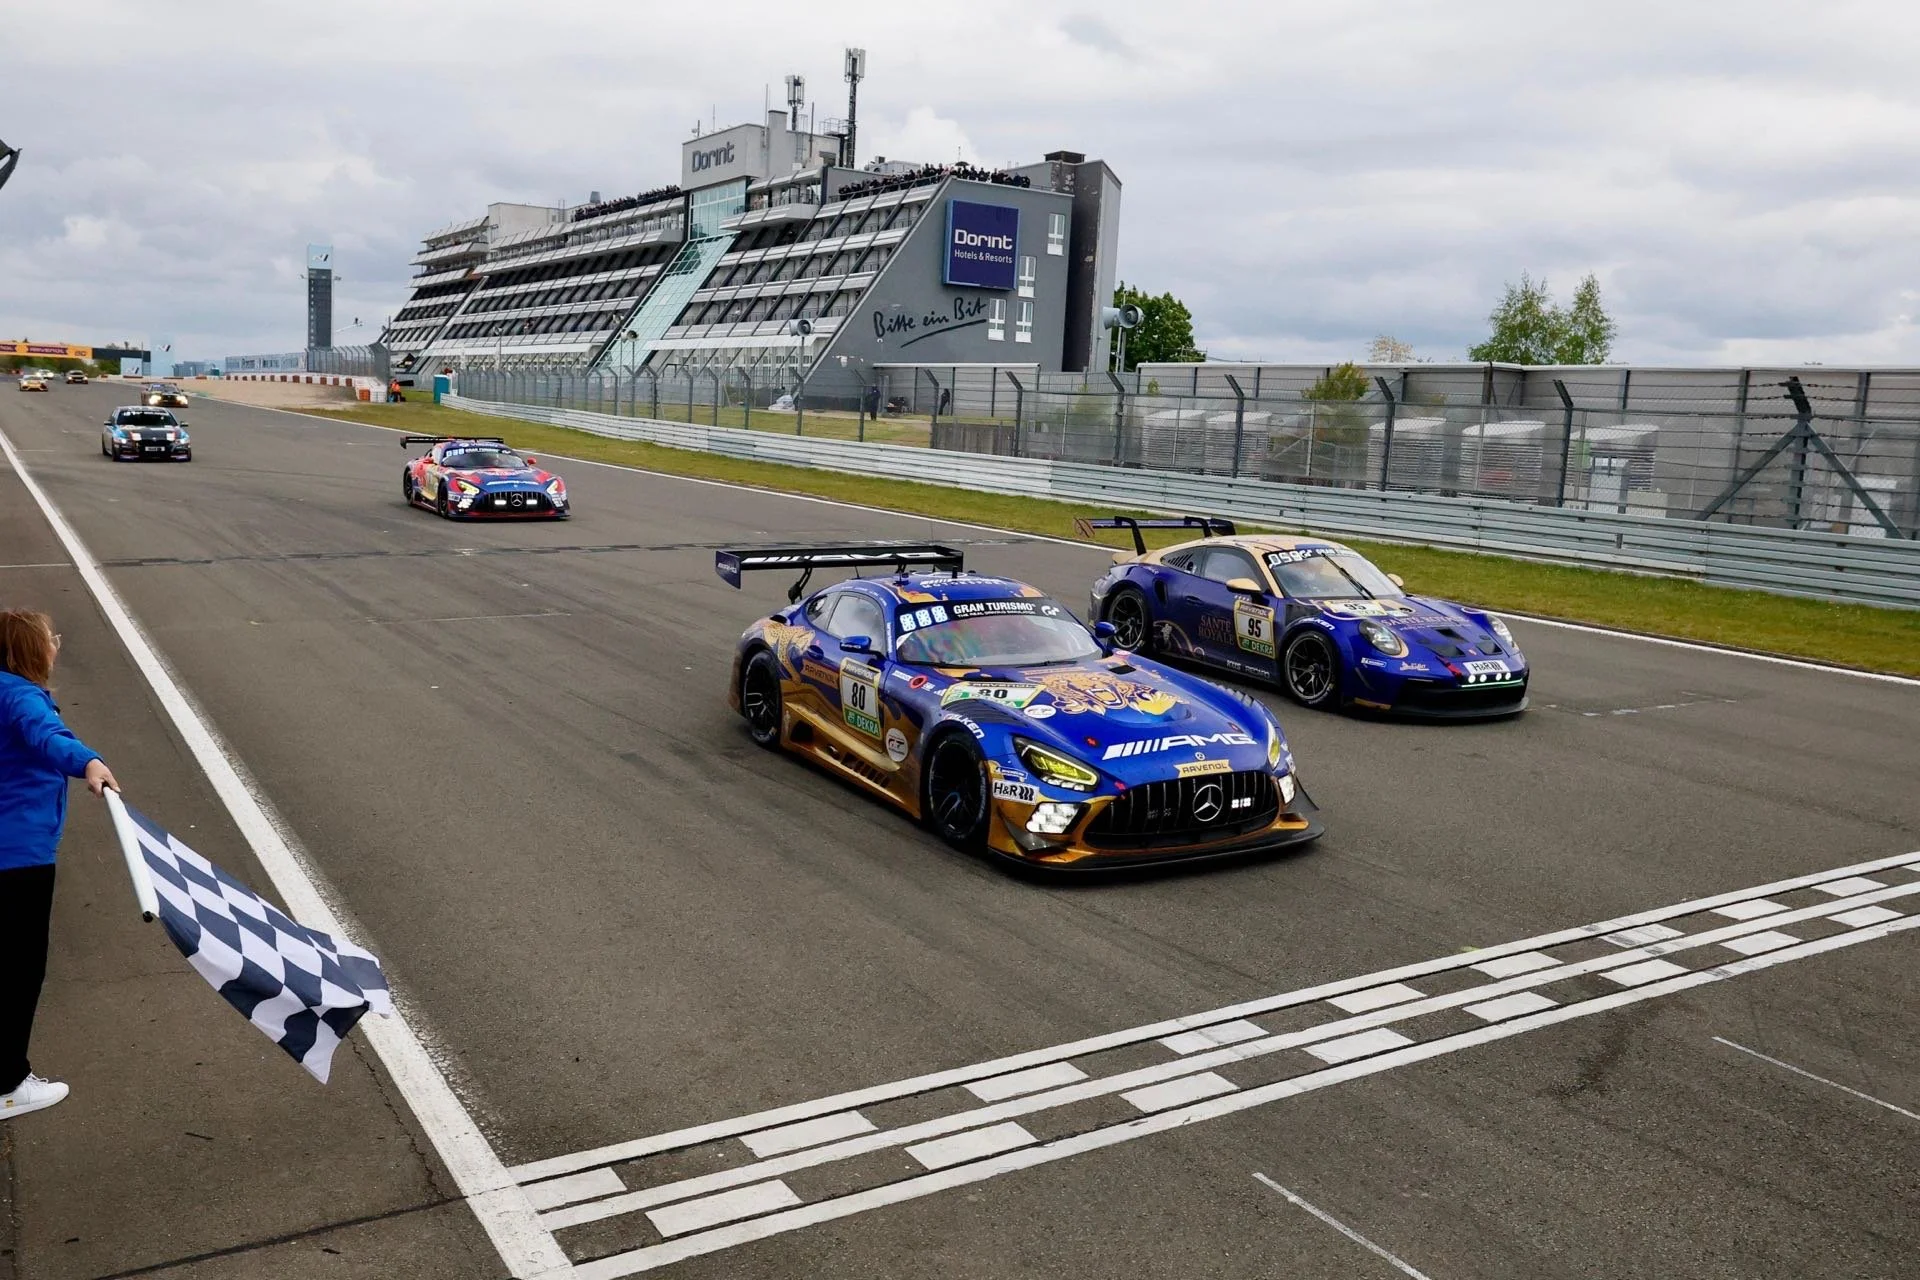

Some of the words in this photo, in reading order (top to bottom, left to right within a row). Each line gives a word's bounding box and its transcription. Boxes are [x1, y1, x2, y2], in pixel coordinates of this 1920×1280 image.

[692, 141, 735, 173] Dorint
[954, 229, 1013, 250] Dorint
[954, 250, 978, 261] Hotels
[979, 252, 985, 261] &
[985, 252, 1013, 264] Resorts
[873, 311, 916, 338] Bitte
[922, 311, 949, 327] ein
[953, 297, 987, 320] Bit
[953, 602, 984, 615] GRAN
[985, 601, 1033, 612] TURISMO
[1343, 603, 1367, 611] 95
[1200, 615, 1232, 632] SANTE
[1248, 618, 1262, 638] 95
[1251, 641, 1273, 655] DEKRA
[851, 682, 866, 710] 80
[856, 713, 880, 736] DEKRA
[1160, 733, 1258, 751] AMG
[1182, 762, 1228, 775] RAVENOL
[994, 782, 1018, 797] H&R
